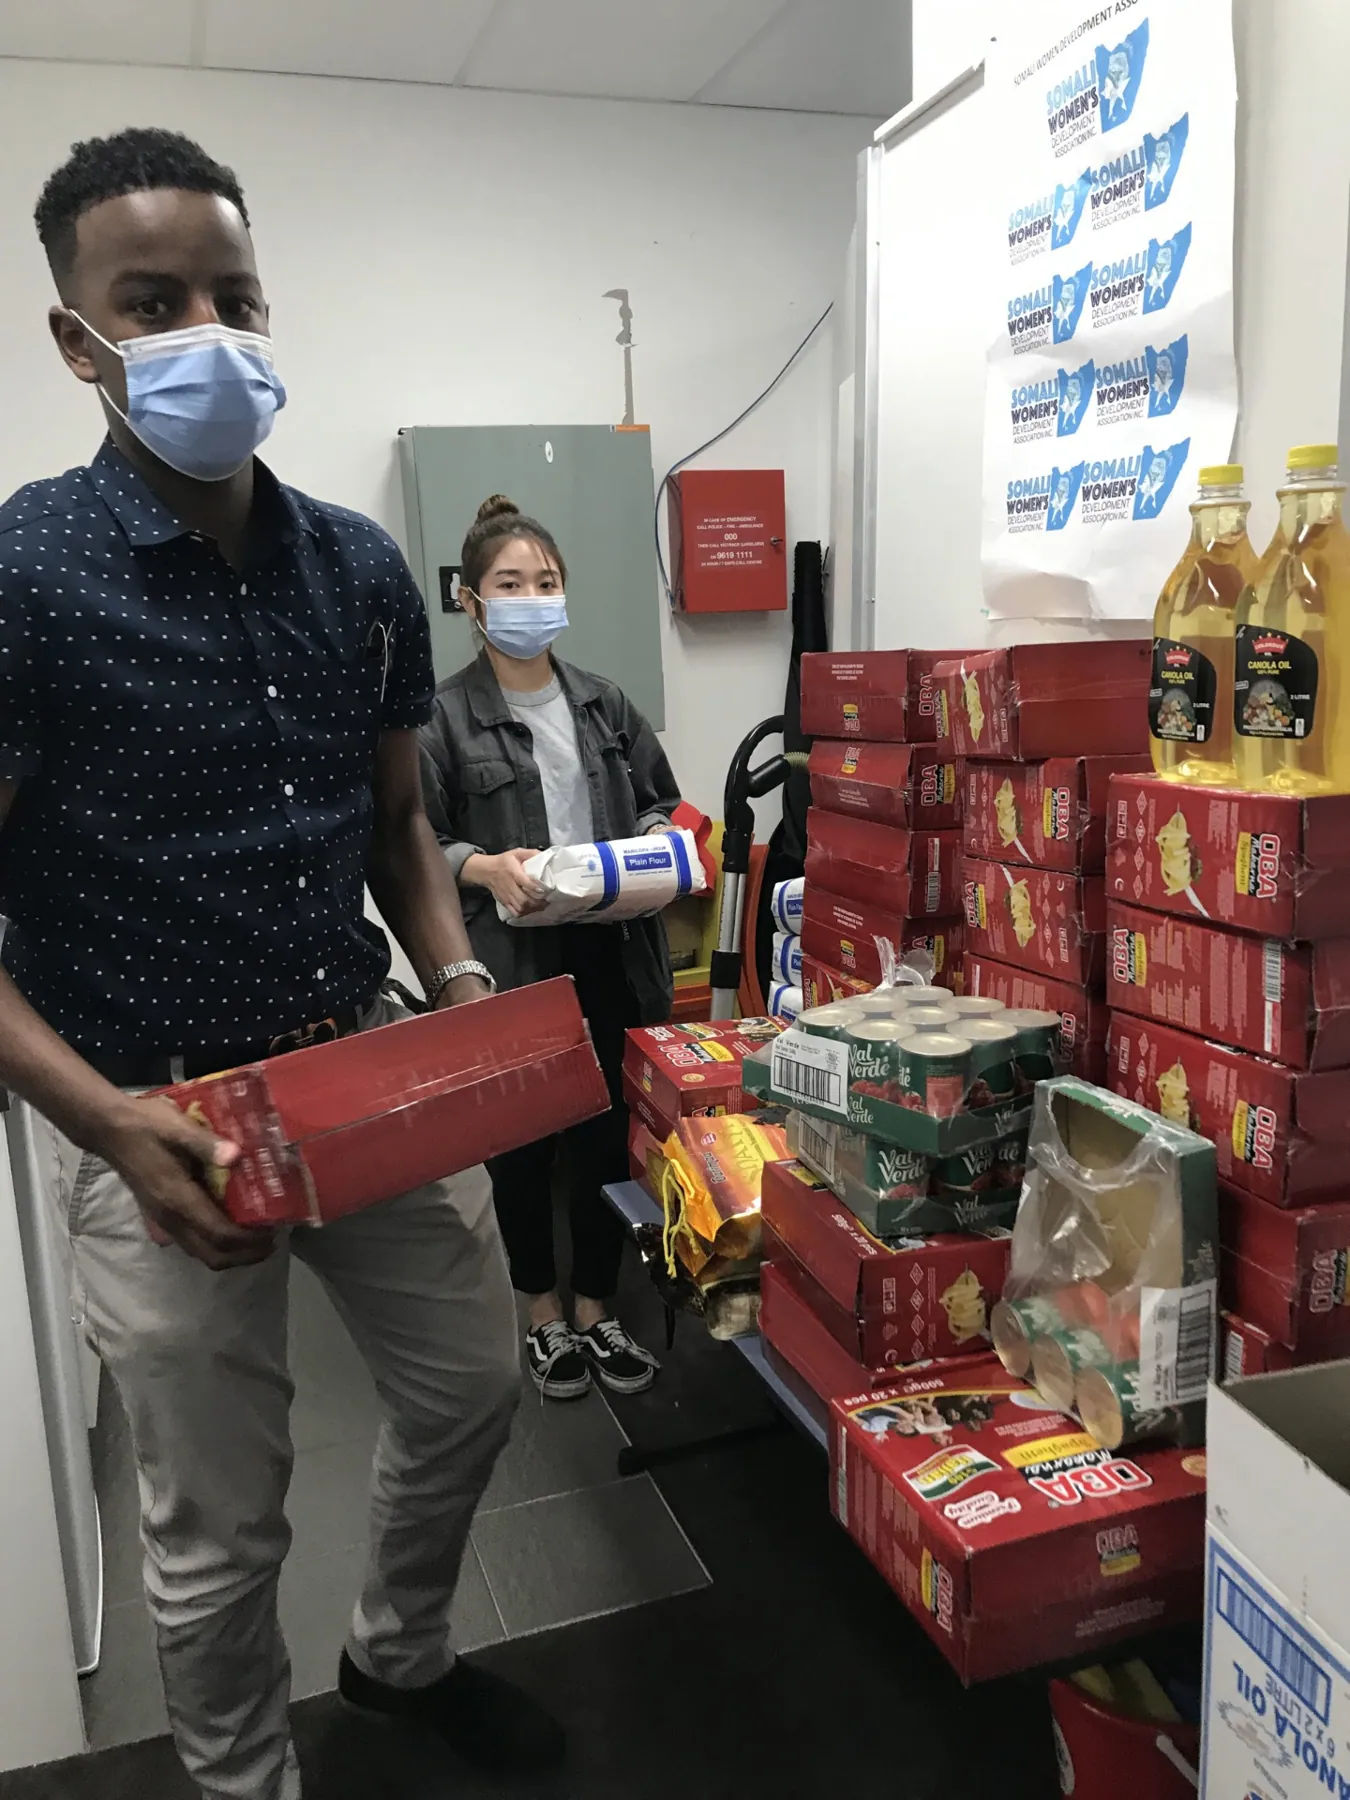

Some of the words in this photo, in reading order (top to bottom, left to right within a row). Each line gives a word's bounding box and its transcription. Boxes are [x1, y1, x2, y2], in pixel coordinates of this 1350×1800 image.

[1036, 46, 1059, 70] WOMEN
[1060, 6, 1112, 52] DEVELOPMENT
[1046, 60, 1096, 115] SOMALI
[1048, 86, 1098, 135] WOMEN'S
[1052, 111, 1095, 148] DEVELOPMENT
[1092, 146, 1144, 192] SOMALI
[1091, 170, 1144, 210] WOMEN'S
[1008, 194, 1054, 232] SOMALI
[1092, 191, 1140, 222] DEVELOPMENT
[1008, 214, 1052, 247] WOMEN'S
[1092, 250, 1146, 290] SOMALI
[1008, 285, 1052, 320] SOMALI
[1090, 274, 1144, 308] WOMEN'S
[1092, 294, 1140, 319] DEVELOPMENT
[1008, 306, 1052, 336] WOMEN'S
[1010, 325, 1049, 347] DEVELOPMENT
[1096, 356, 1147, 388] SOMALI
[1012, 378, 1058, 408] SOMALI
[1096, 378, 1149, 406] WOMEN'S
[1096, 398, 1145, 416] DEVELOPMENT
[1011, 399, 1058, 424] WOMEN'S
[1012, 418, 1054, 435] DEVELOPMENT
[1084, 454, 1140, 484] SOMALI
[1007, 475, 1051, 499] SOMALI
[1082, 478, 1136, 502] WOMEN'S
[1007, 494, 1048, 514] WOMEN'S
[1008, 512, 1044, 525] DEVELOPMENT
[1082, 498, 1130, 514] DEVELOPMENT
[1161, 671, 1183, 679] CANOLA
[1184, 672, 1194, 680] OIL
[1248, 661, 1277, 669] CANOLA
[1278, 661, 1292, 669] OIL
[921, 764, 938, 806] OBA
[1056, 787, 1070, 840] OBA
[629, 858, 648, 866] Plain
[1249, 836, 1258, 896] Makarna
[1257, 833, 1280, 898] OBA
[965, 882, 976, 928] OBA
[1113, 928, 1130, 984] OBA
[1253, 1106, 1276, 1168] OBA
[879, 1150, 912, 1172] Val
[1309, 1250, 1338, 1313] OBA
[1019, 1438, 1090, 1462] Spaghetti
[1024, 1450, 1112, 1474] Makarna
[1029, 1459, 1152, 1506] OBA
[1233, 1661, 1266, 1716] OIL
[1266, 1672, 1300, 1722] LITRE
[1304, 1713, 1314, 1735] 2
[1274, 1706, 1350, 1800] ANOLA
[1327, 1737, 1335, 1759] 6
